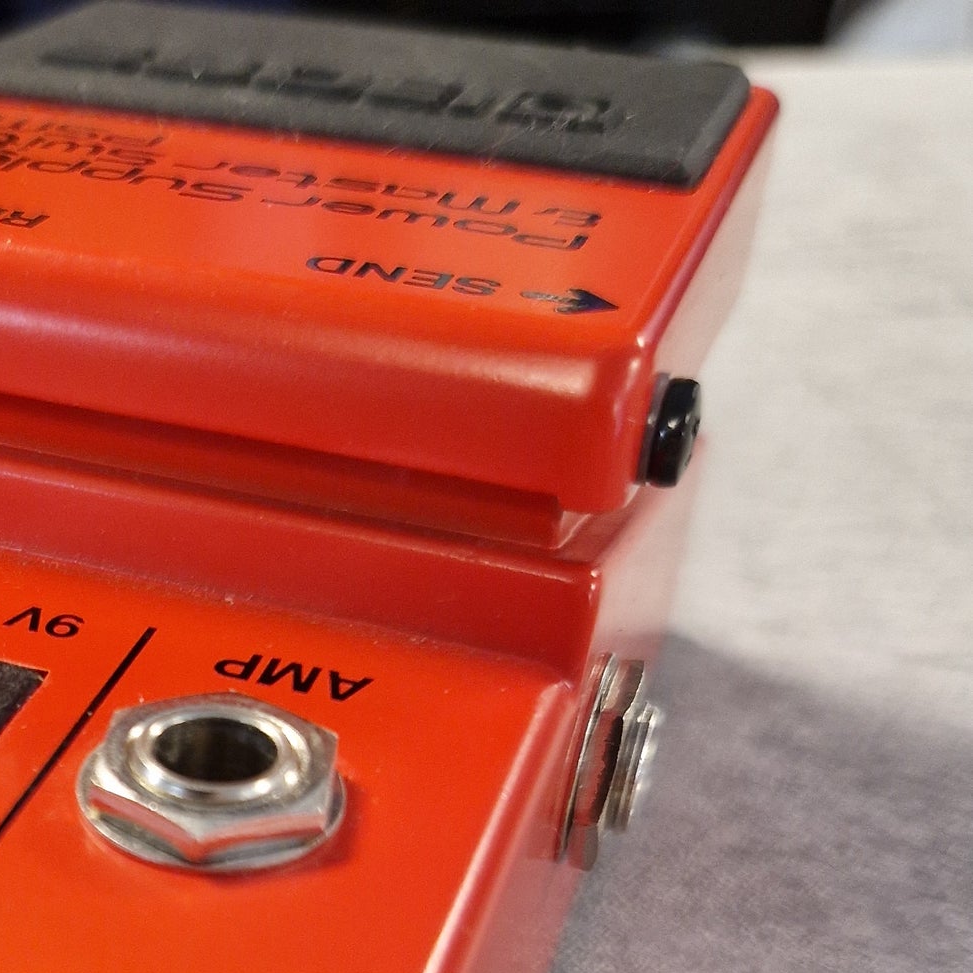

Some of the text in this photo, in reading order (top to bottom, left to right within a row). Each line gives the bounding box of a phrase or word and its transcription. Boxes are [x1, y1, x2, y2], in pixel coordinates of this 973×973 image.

[260, 195, 589, 251] Power
[306, 256, 502, 297] SEND
[3, 606, 85, 639] 9V
[213, 653, 375, 702] AMP
